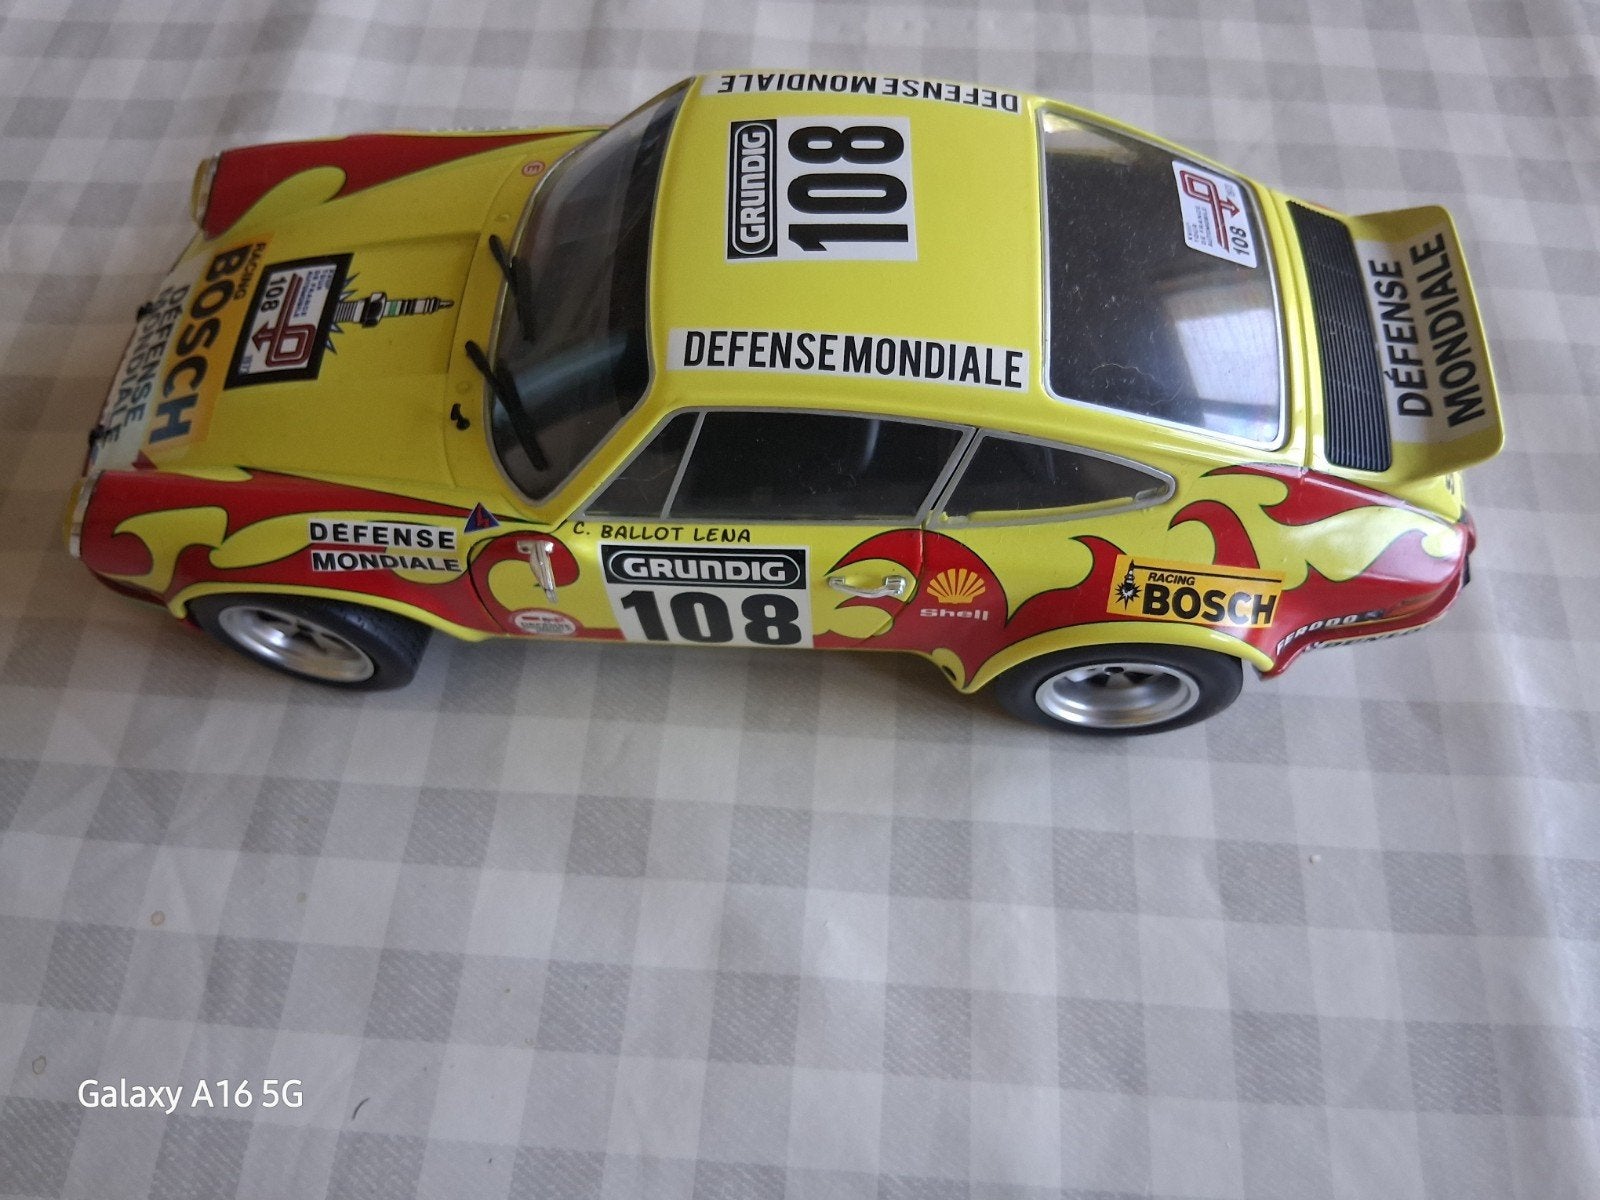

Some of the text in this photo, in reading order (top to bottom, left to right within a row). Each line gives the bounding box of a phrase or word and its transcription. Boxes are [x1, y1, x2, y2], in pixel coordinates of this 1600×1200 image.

[717, 73, 1019, 113] DEFENSE MONDIALE
[740, 131, 767, 244] GRUNDIG
[787, 125, 909, 252] 108
[1230, 225, 1250, 256] 108
[233, 241, 267, 300] RACING
[260, 275, 288, 313] 108
[149, 243, 253, 444] BOSCH
[1368, 258, 1433, 418] DÉFENSE
[1408, 232, 1486, 428] MONDIALE
[683, 330, 1024, 389] DEFENSE MONDIALE
[573, 520, 751, 543] C. BALLOT LENA
[312, 552, 462, 573] MONDIALE
[622, 556, 789, 582] GRUNDIG
[1147, 571, 1196, 586] RACING
[619, 589, 803, 646] 108
[919, 607, 989, 621] Shell
[1141, 583, 1278, 626] BOSCH
